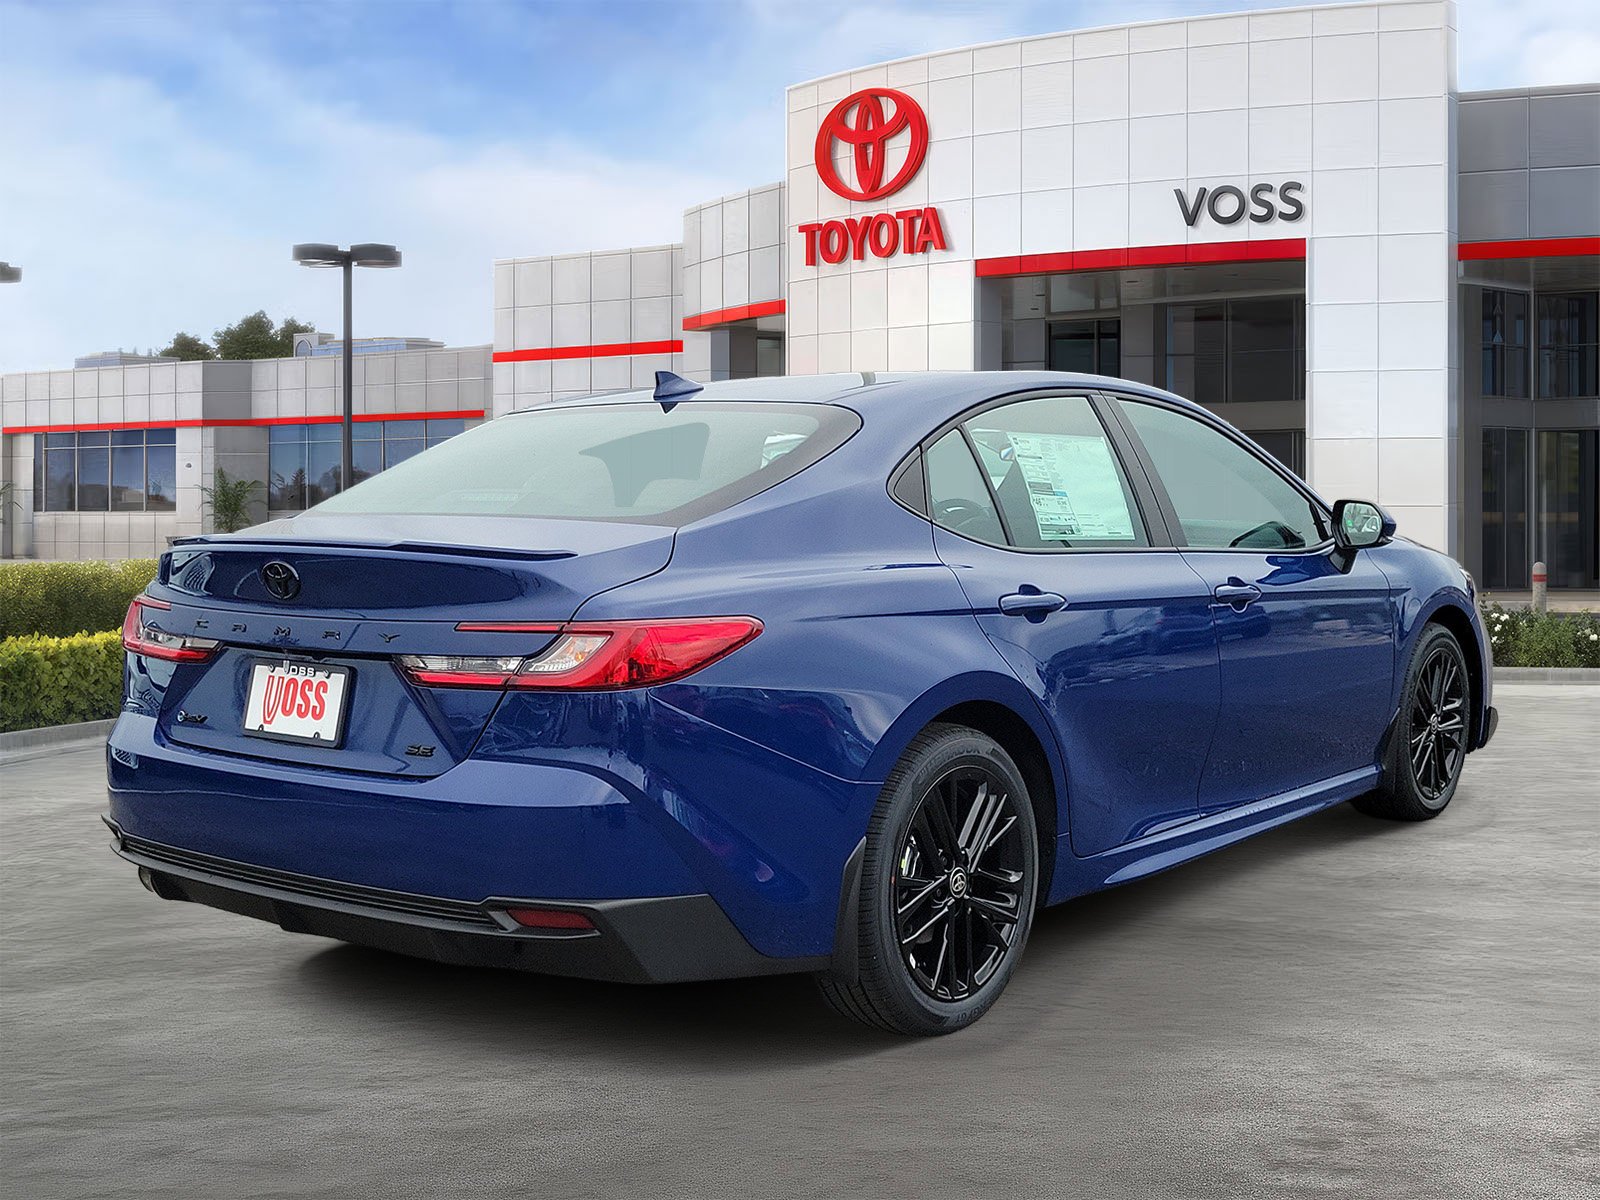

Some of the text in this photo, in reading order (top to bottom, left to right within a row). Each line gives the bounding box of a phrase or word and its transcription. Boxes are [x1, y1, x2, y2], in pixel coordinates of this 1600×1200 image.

[1174, 181, 1305, 227] VOSS
[799, 207, 949, 266] TOYOTA
[196, 619, 401, 643] CAMRY
[263, 675, 328, 725] VOSS
